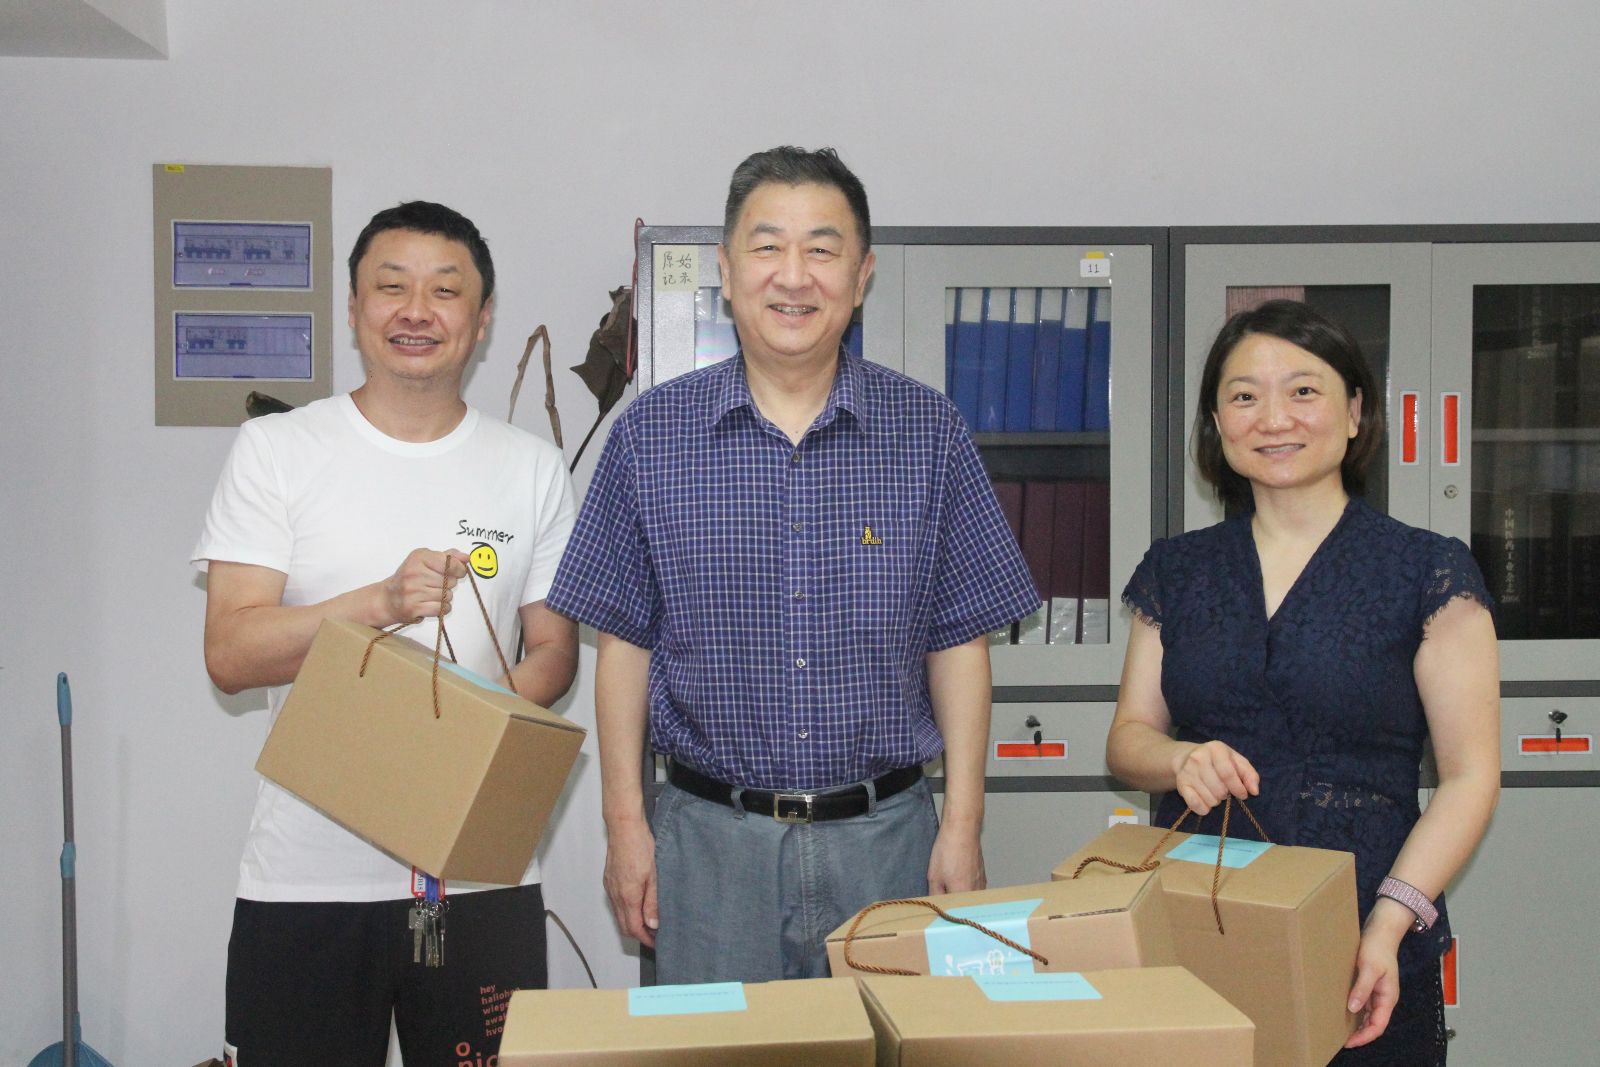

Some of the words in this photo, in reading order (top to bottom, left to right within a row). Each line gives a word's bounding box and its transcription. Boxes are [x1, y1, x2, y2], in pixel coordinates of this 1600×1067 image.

[662, 251, 692, 270] 原始
[1088, 263, 1100, 273] 11
[662, 272, 693, 285] 记录
[456, 519, 514, 544] Summer
[480, 984, 496, 994] hey
